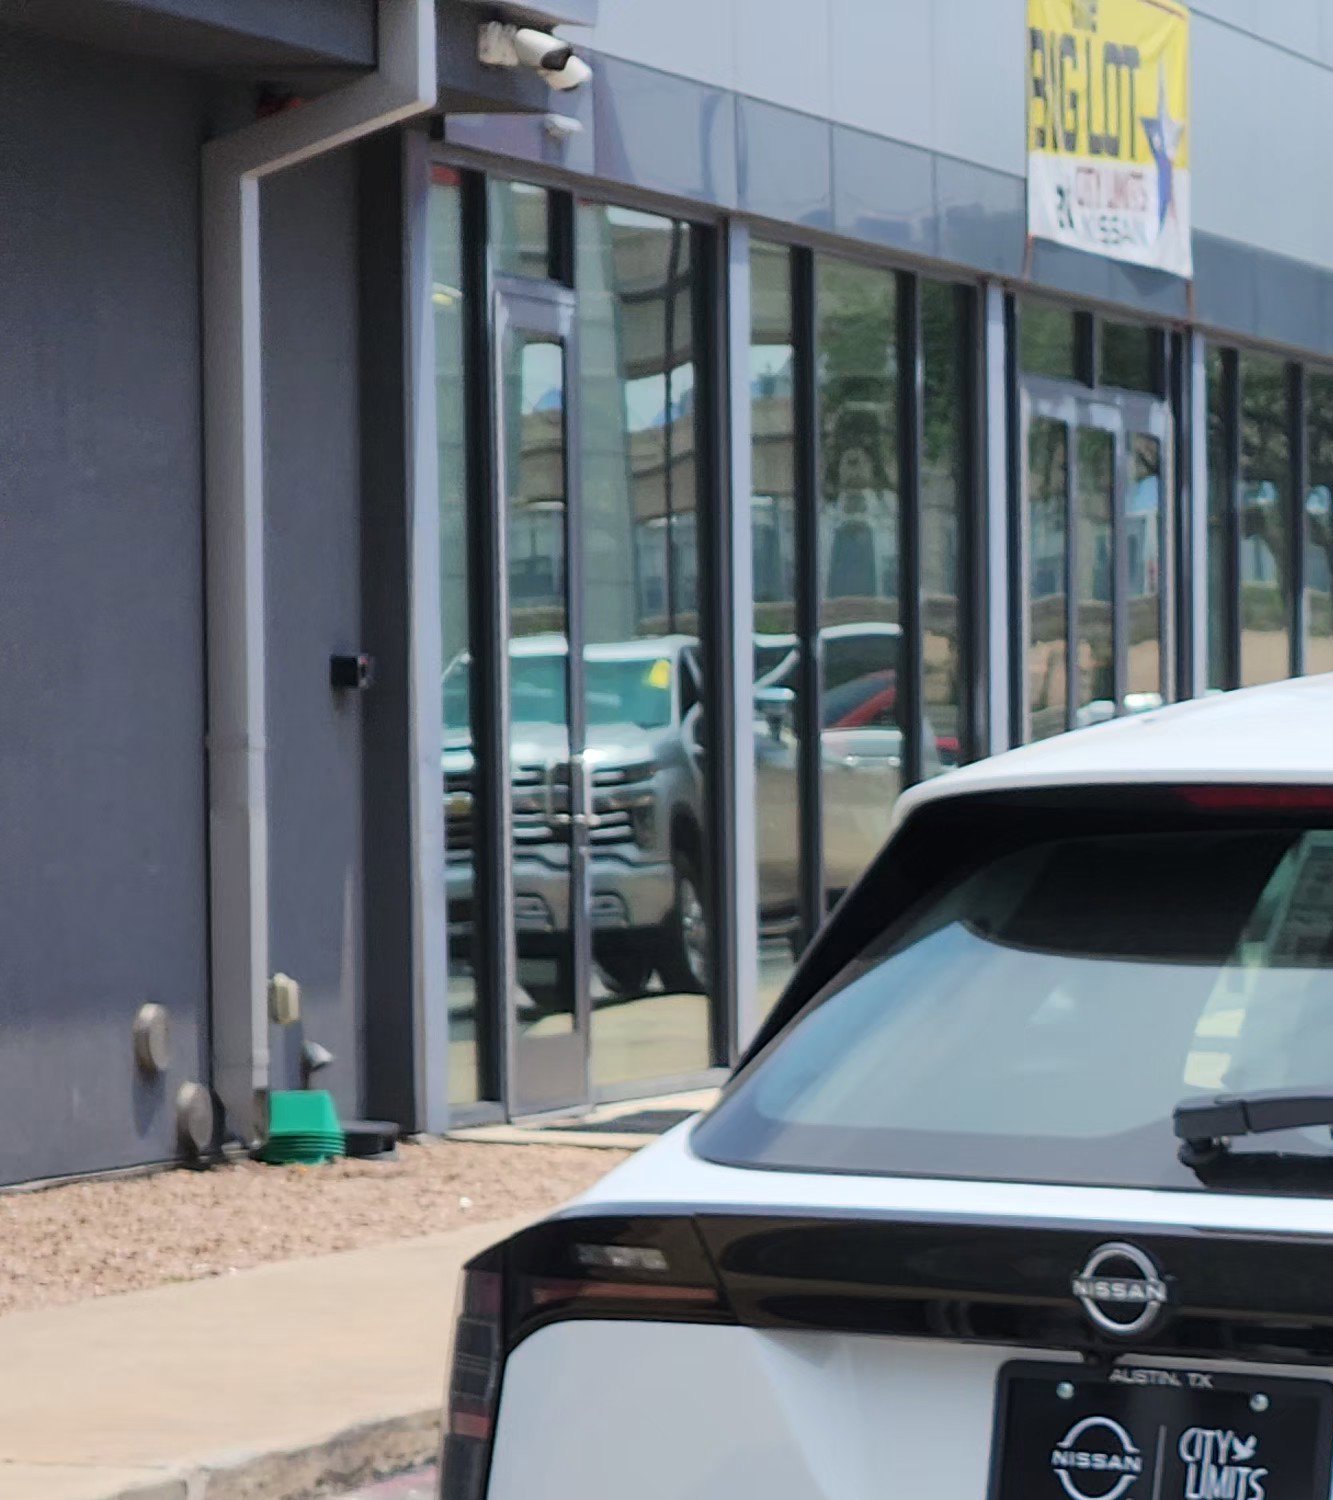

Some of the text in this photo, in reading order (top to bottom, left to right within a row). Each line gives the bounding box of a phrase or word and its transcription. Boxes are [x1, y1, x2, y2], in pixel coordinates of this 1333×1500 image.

[1029, 27, 1140, 159] BIG LOT
[1073, 1275, 1167, 1303] NISSAN
[1187, 1372, 1213, 1388] TX
[1179, 1427, 1235, 1465] CITY
[1052, 1449, 1143, 1474] NISSAN
